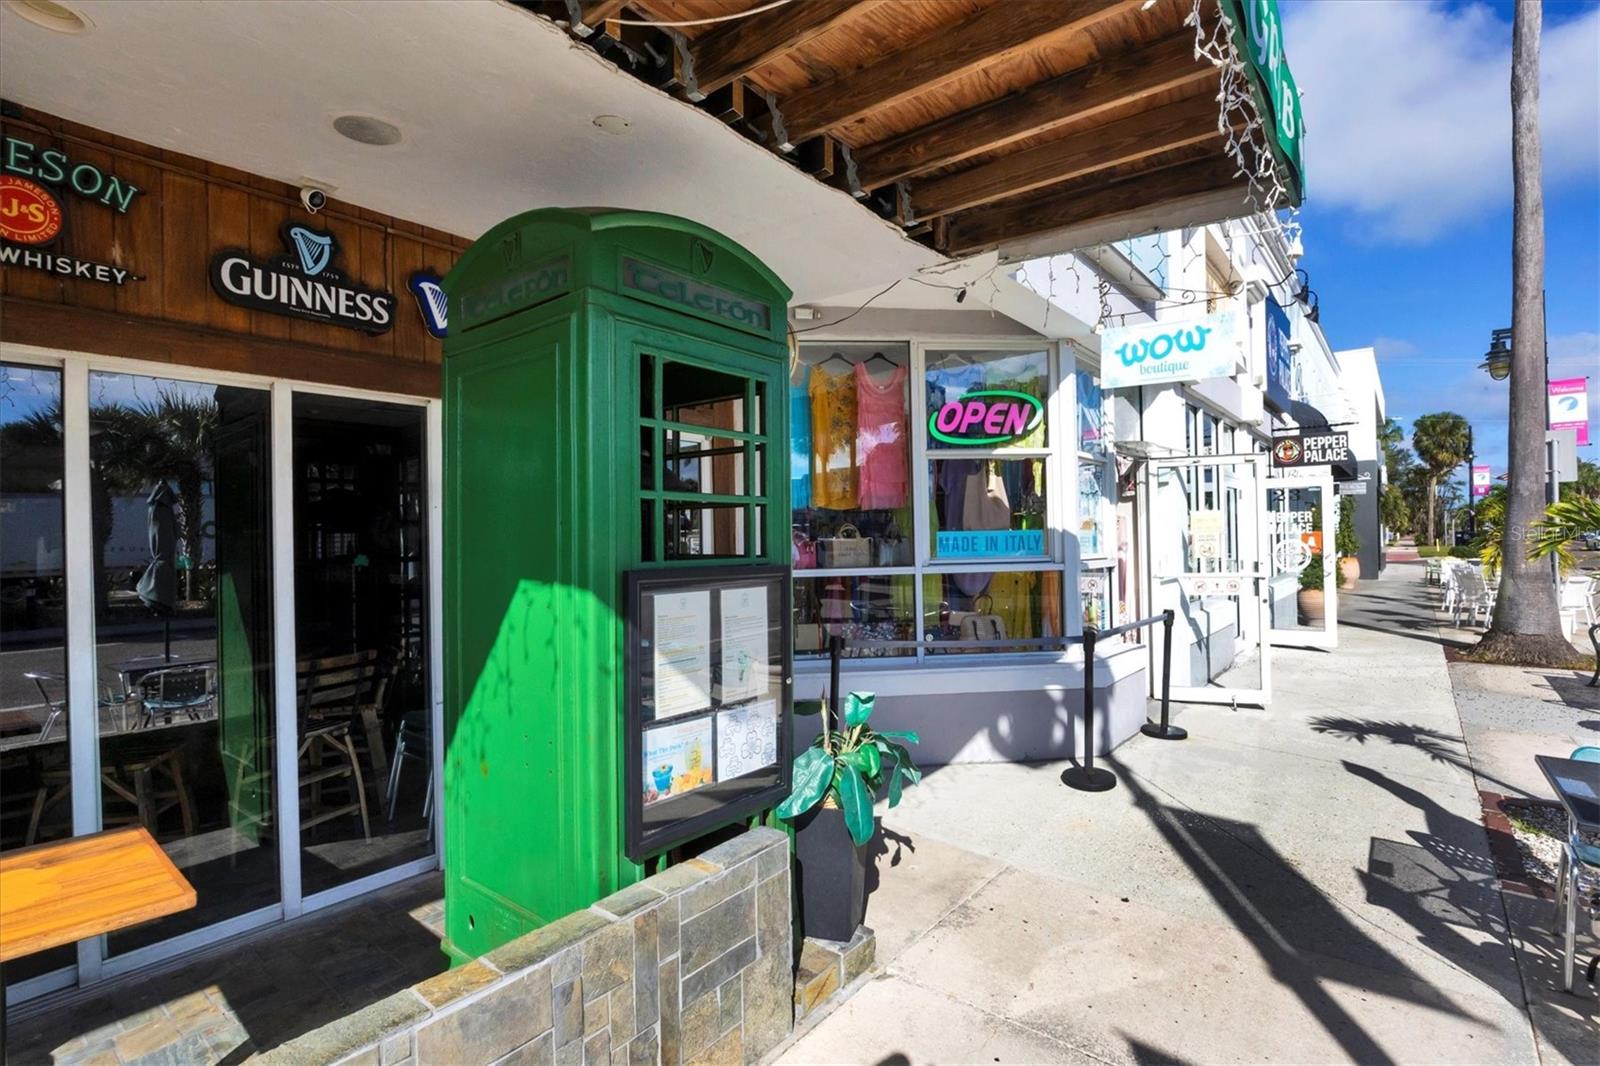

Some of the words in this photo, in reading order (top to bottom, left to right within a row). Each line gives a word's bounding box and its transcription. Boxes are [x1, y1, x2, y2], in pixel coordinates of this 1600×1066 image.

[5, 137, 139, 213] ESON
[8, 177, 59, 215] JAMESON
[15, 223, 58, 241] LIMITED
[0, 248, 128, 284] WHISKEY
[220, 257, 390, 325] GUINNESS
[1139, 360, 1190, 376] boutique
[1551, 385, 1585, 394] Welcome
[936, 402, 1033, 435] OPEN
[1303, 434, 1348, 450] PEPPER
[1303, 447, 1348, 463] PALACE
[938, 537, 978, 553] MADE
[985, 535, 1002, 551] IN
[1004, 534, 1042, 551] ITALY
